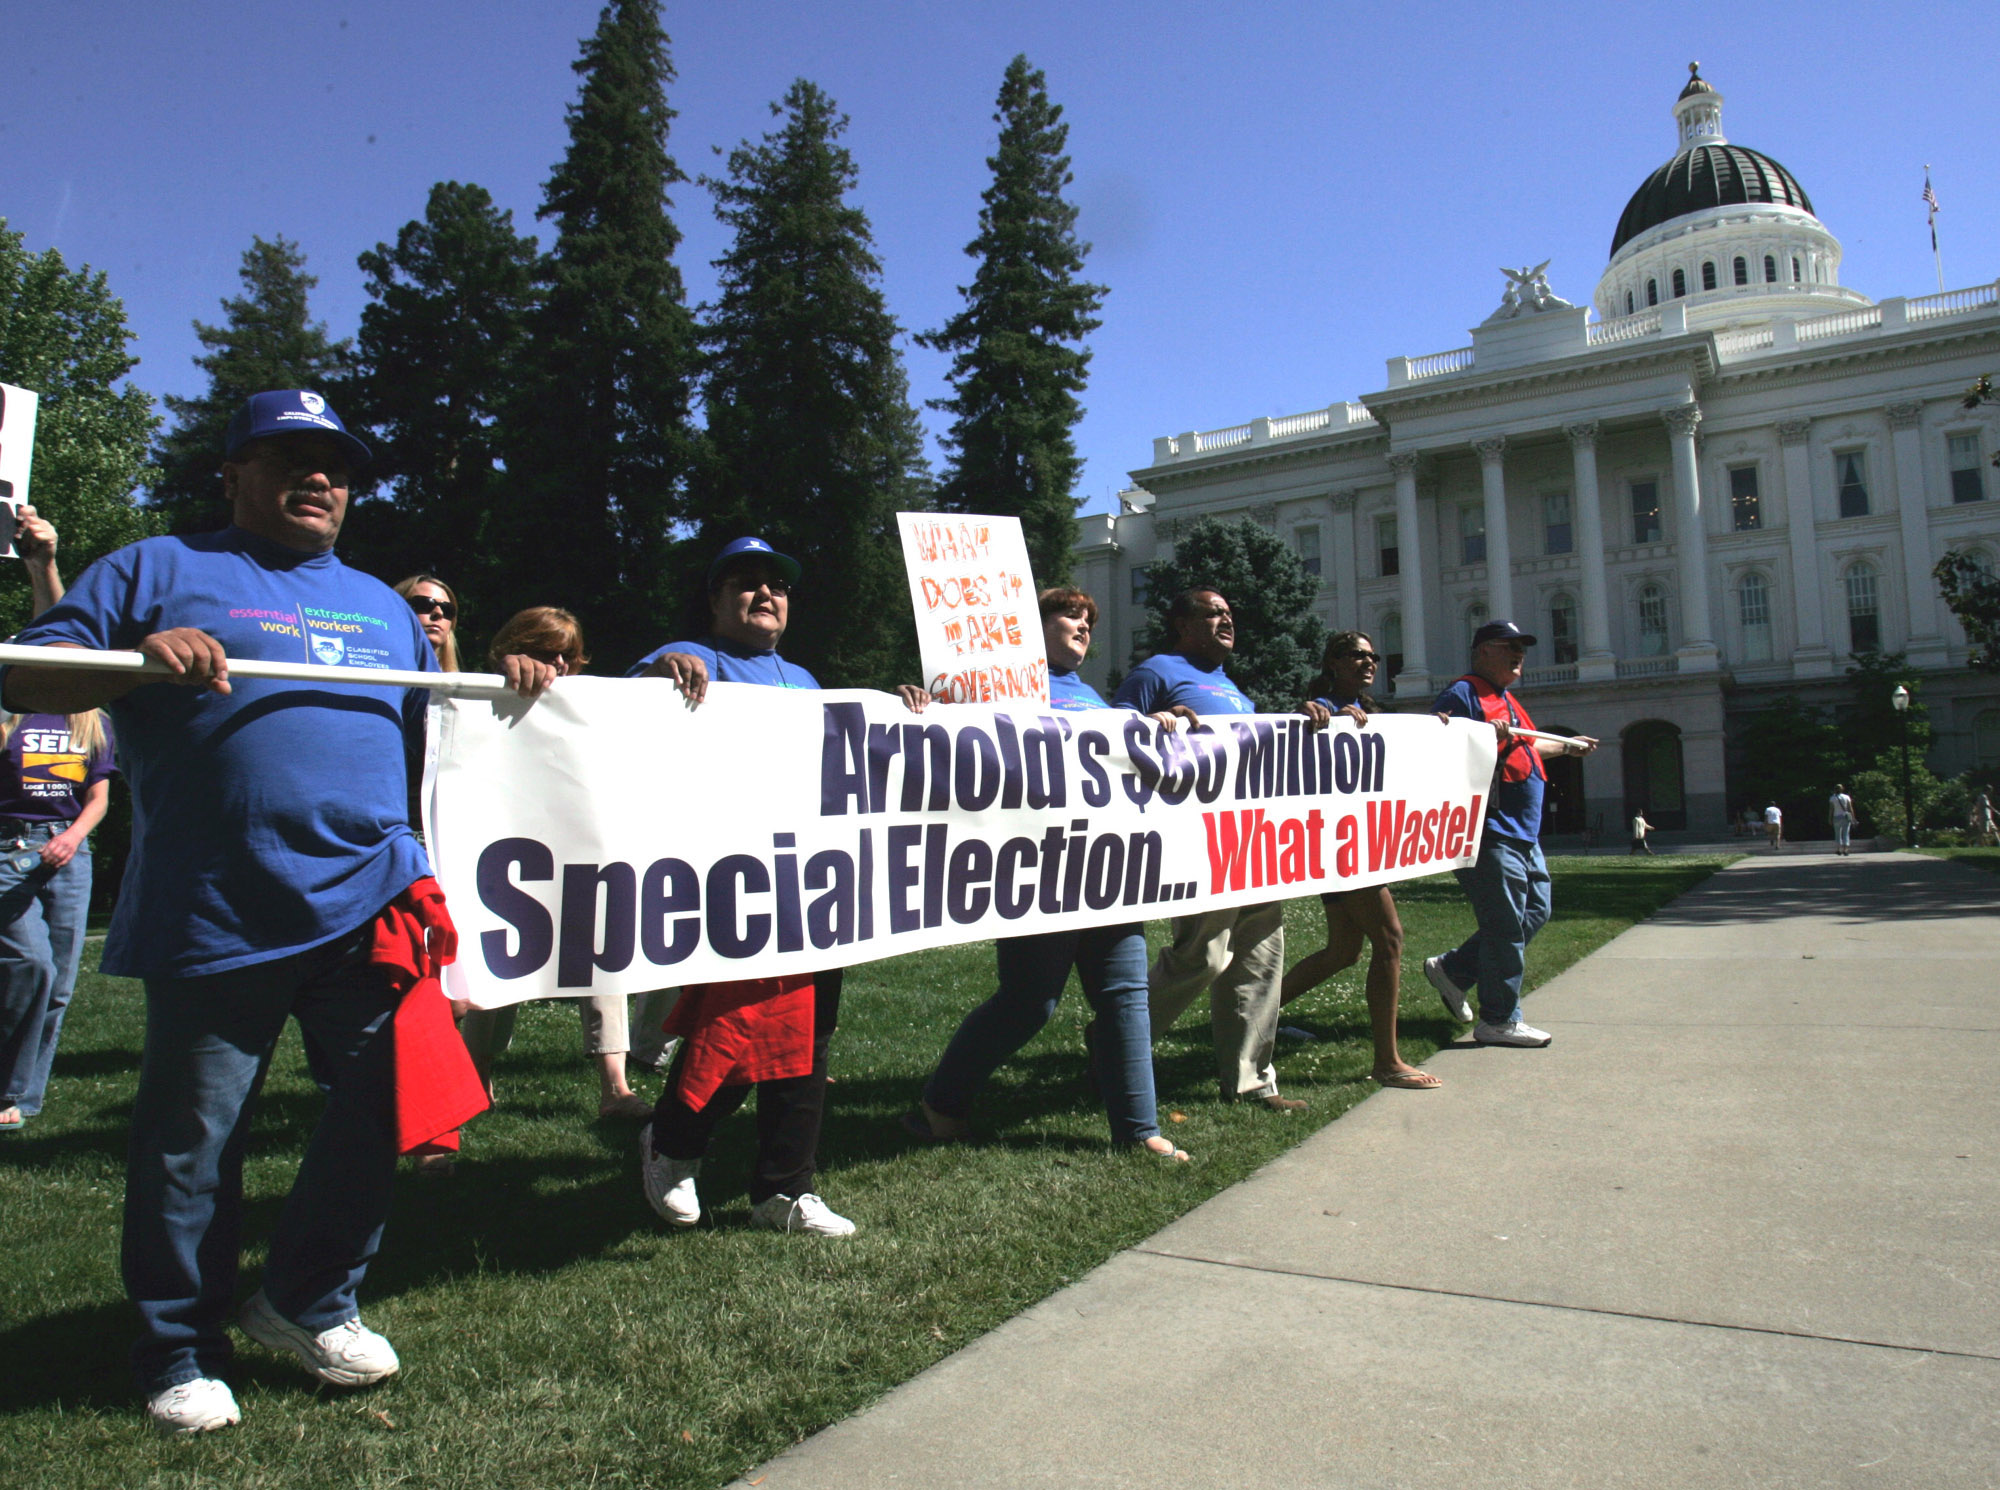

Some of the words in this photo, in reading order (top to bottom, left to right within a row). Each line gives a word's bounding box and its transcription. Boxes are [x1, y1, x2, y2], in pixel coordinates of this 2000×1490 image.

[913, 521, 990, 567] WHAT
[921, 570, 992, 611] DOES
[229, 608, 298, 625] essential
[259, 621, 302, 639] work
[305, 607, 389, 631] extraordinary
[307, 618, 364, 634] workers
[942, 612, 1023, 656] TAKE
[820, 702, 1111, 816] Arnold's
[1230, 719, 1385, 800] Million
[477, 829, 873, 988] Special
[888, 819, 1198, 935] Election...
[1202, 808, 1325, 895] What
[1335, 814, 1359, 878] a
[1366, 795, 1482, 873] Waste!
